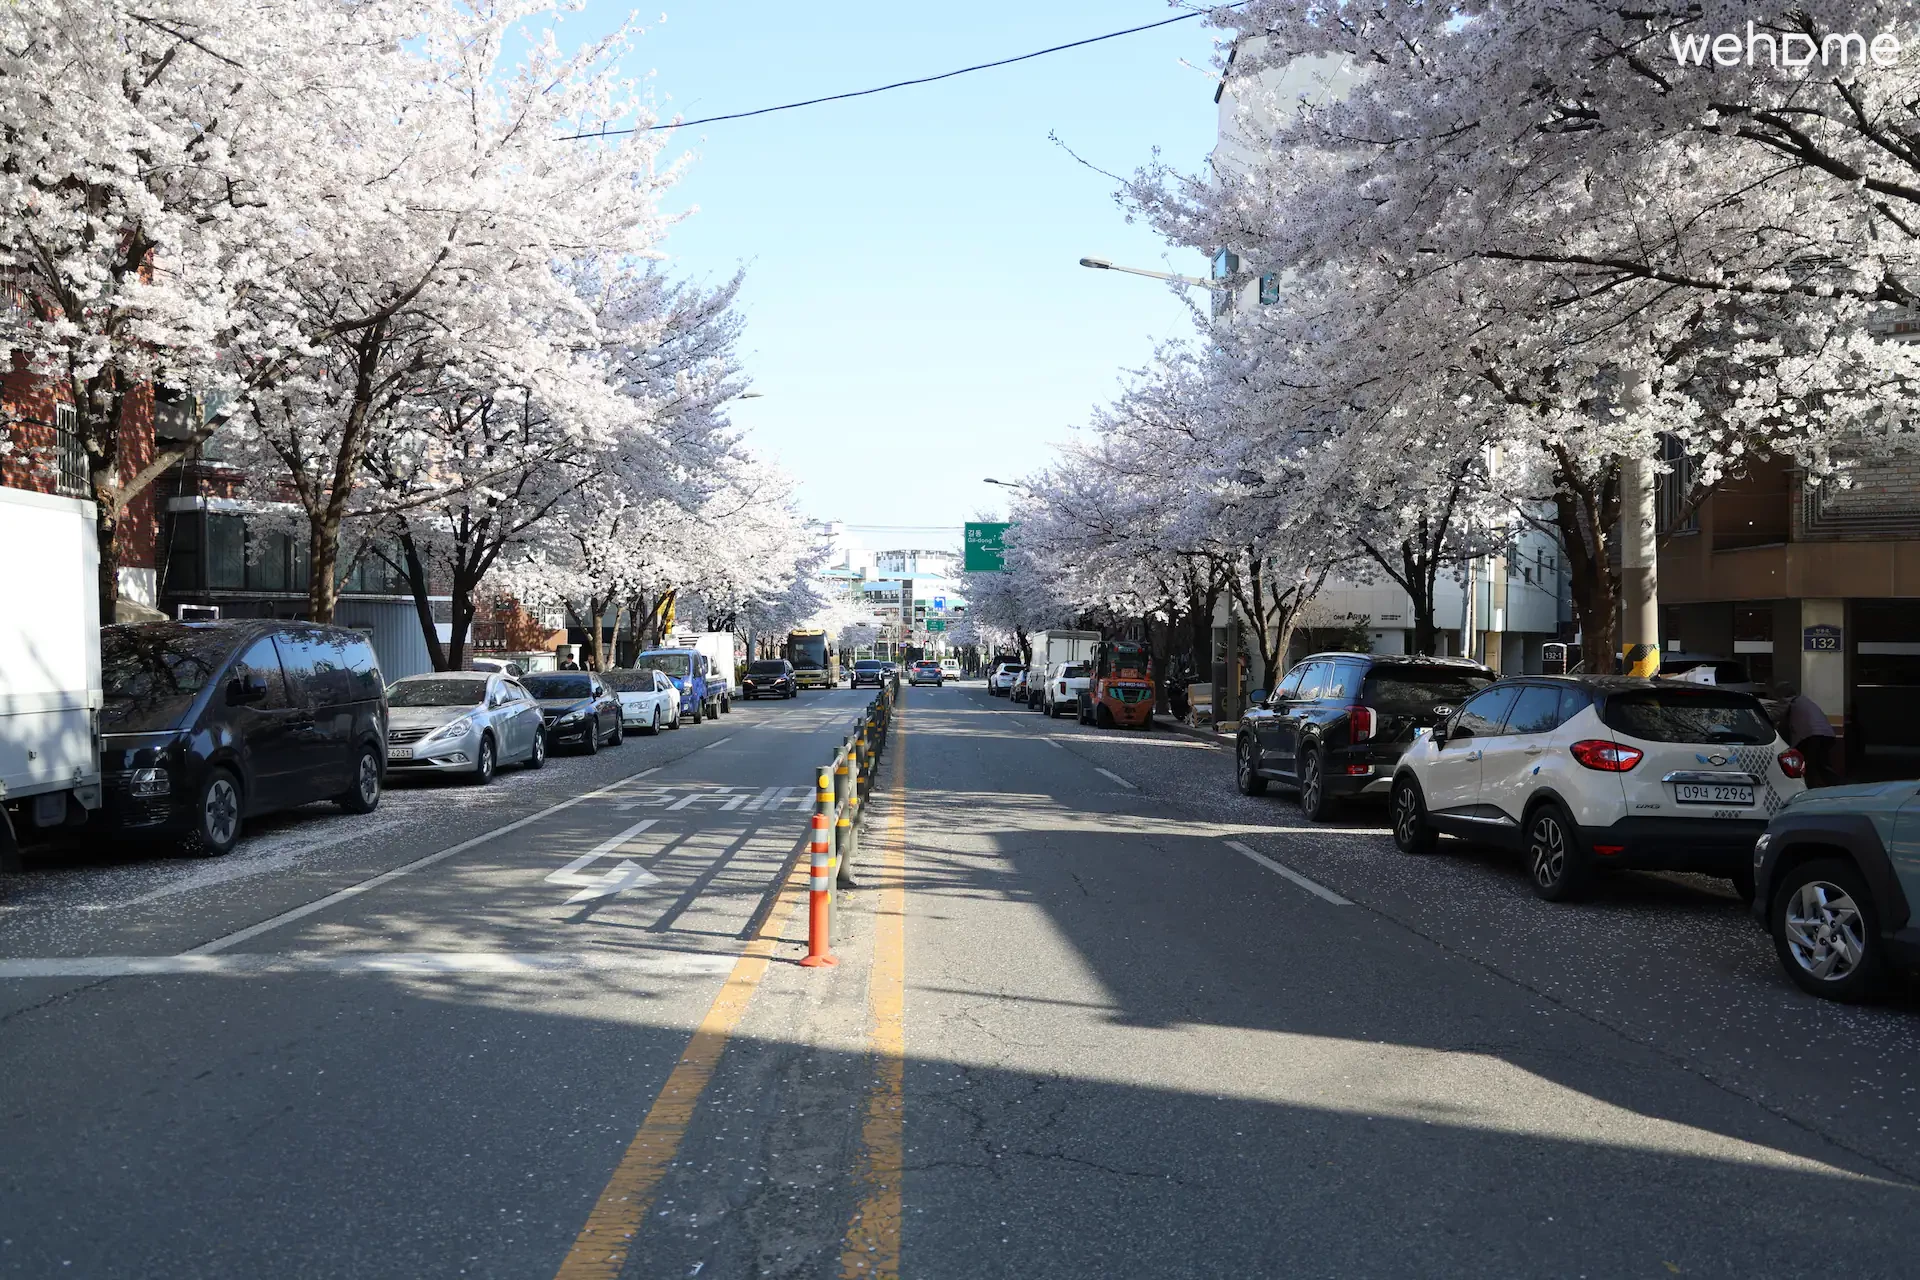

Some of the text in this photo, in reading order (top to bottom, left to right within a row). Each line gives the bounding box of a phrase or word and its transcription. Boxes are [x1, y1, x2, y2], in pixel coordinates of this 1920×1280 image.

[967, 529, 982, 537] 길동
[1810, 637, 1836, 649] 132
[1544, 652, 1562, 660] 132-1
[391, 749, 409, 757] 6231
[1683, 786, 1747, 801] 09너 2296
